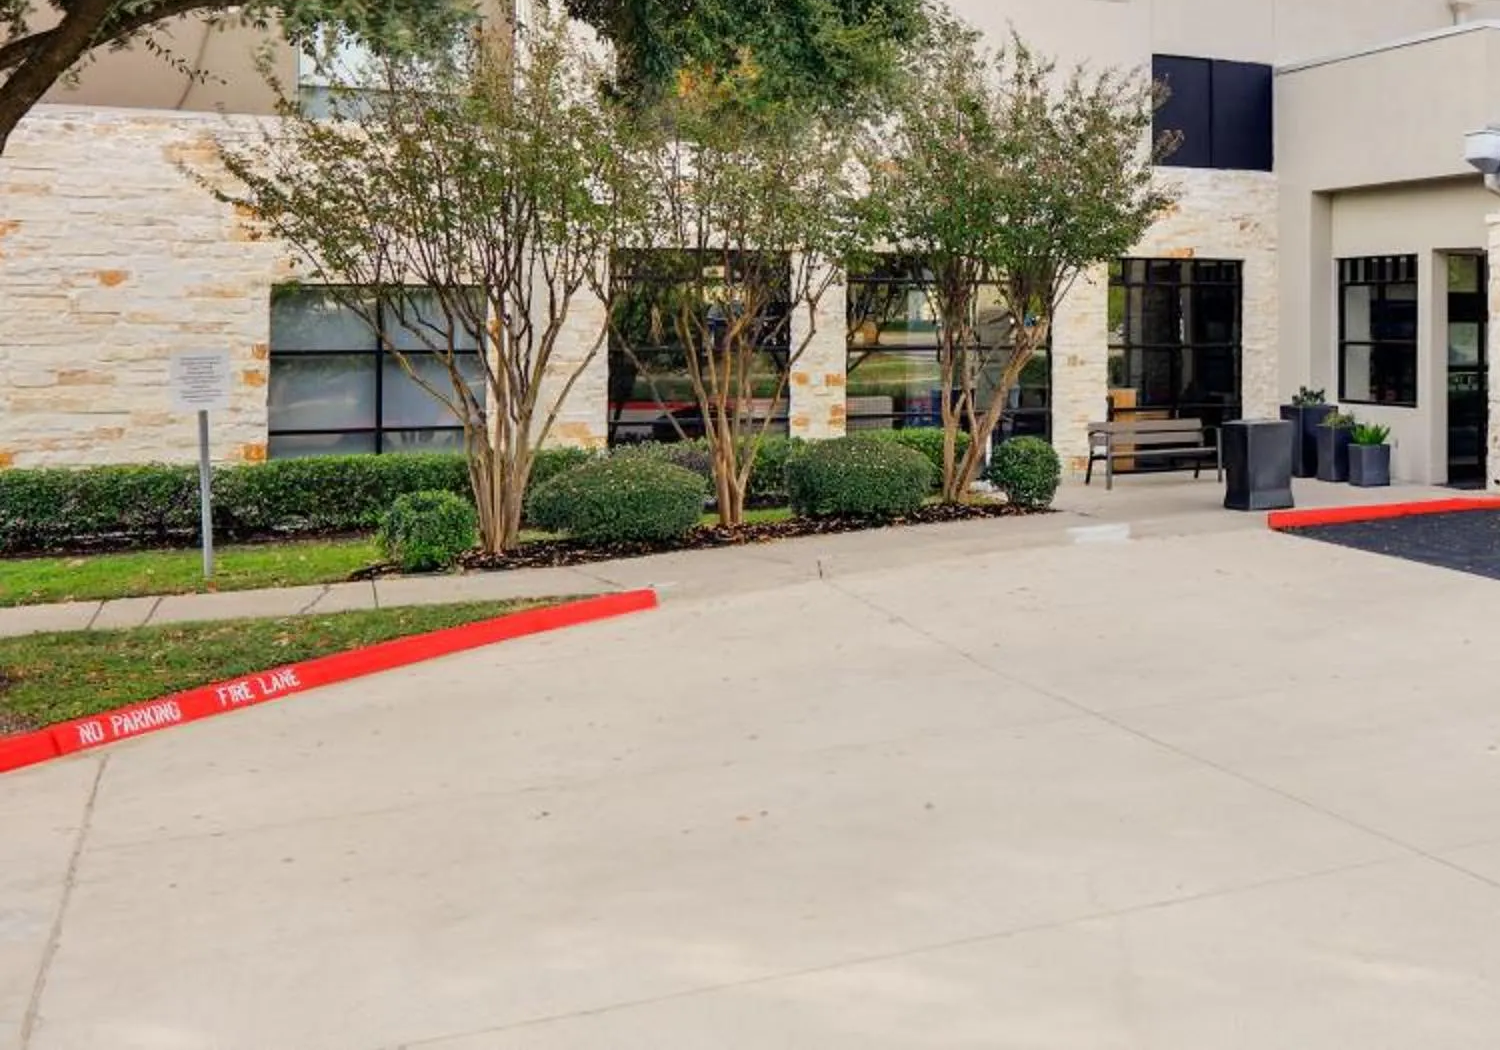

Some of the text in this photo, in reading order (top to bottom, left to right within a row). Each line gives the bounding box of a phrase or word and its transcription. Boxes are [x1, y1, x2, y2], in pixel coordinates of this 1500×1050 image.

[78, 668, 300, 744] NO PARKING FIRE LANE
